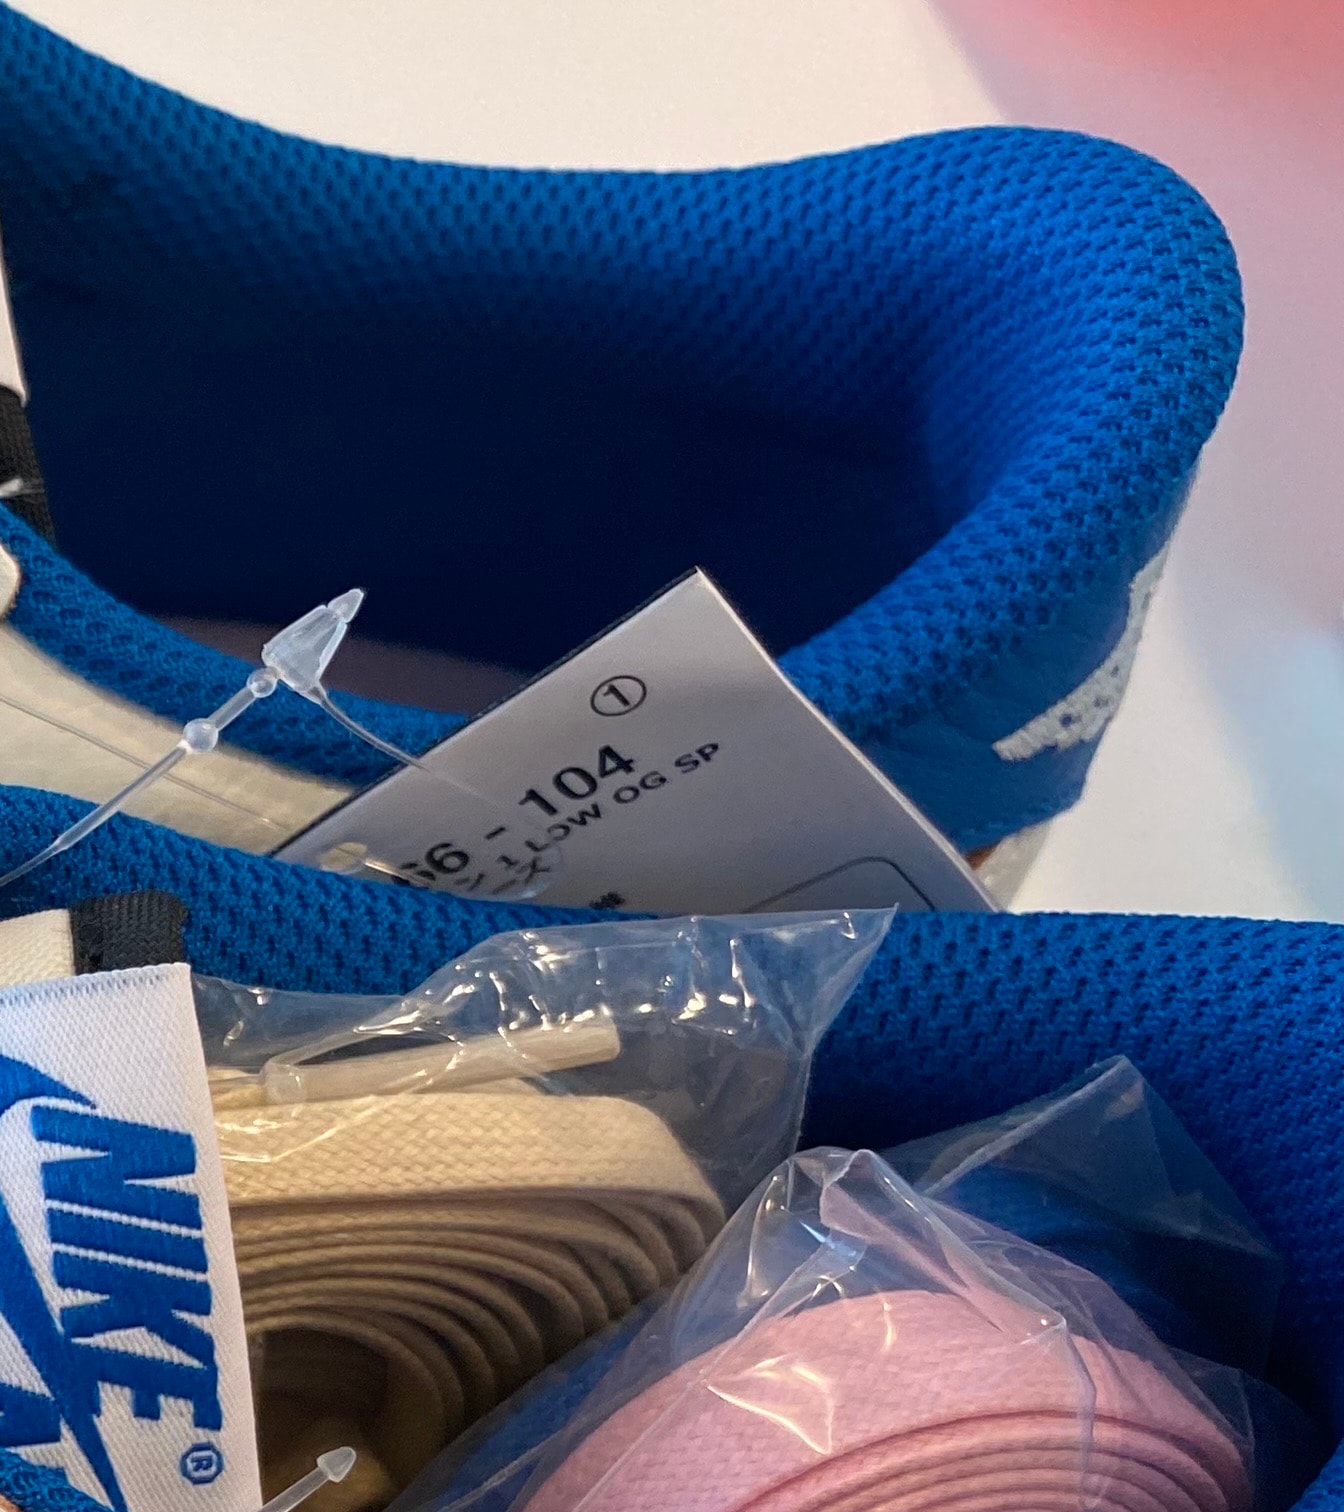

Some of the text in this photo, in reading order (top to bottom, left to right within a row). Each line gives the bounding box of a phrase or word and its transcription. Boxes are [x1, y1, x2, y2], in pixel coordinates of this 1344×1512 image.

[518, 745, 635, 816] 104
[613, 771, 667, 804] OG
[674, 743, 720, 774] SP
[30, 1105, 224, 1432] NIKE
